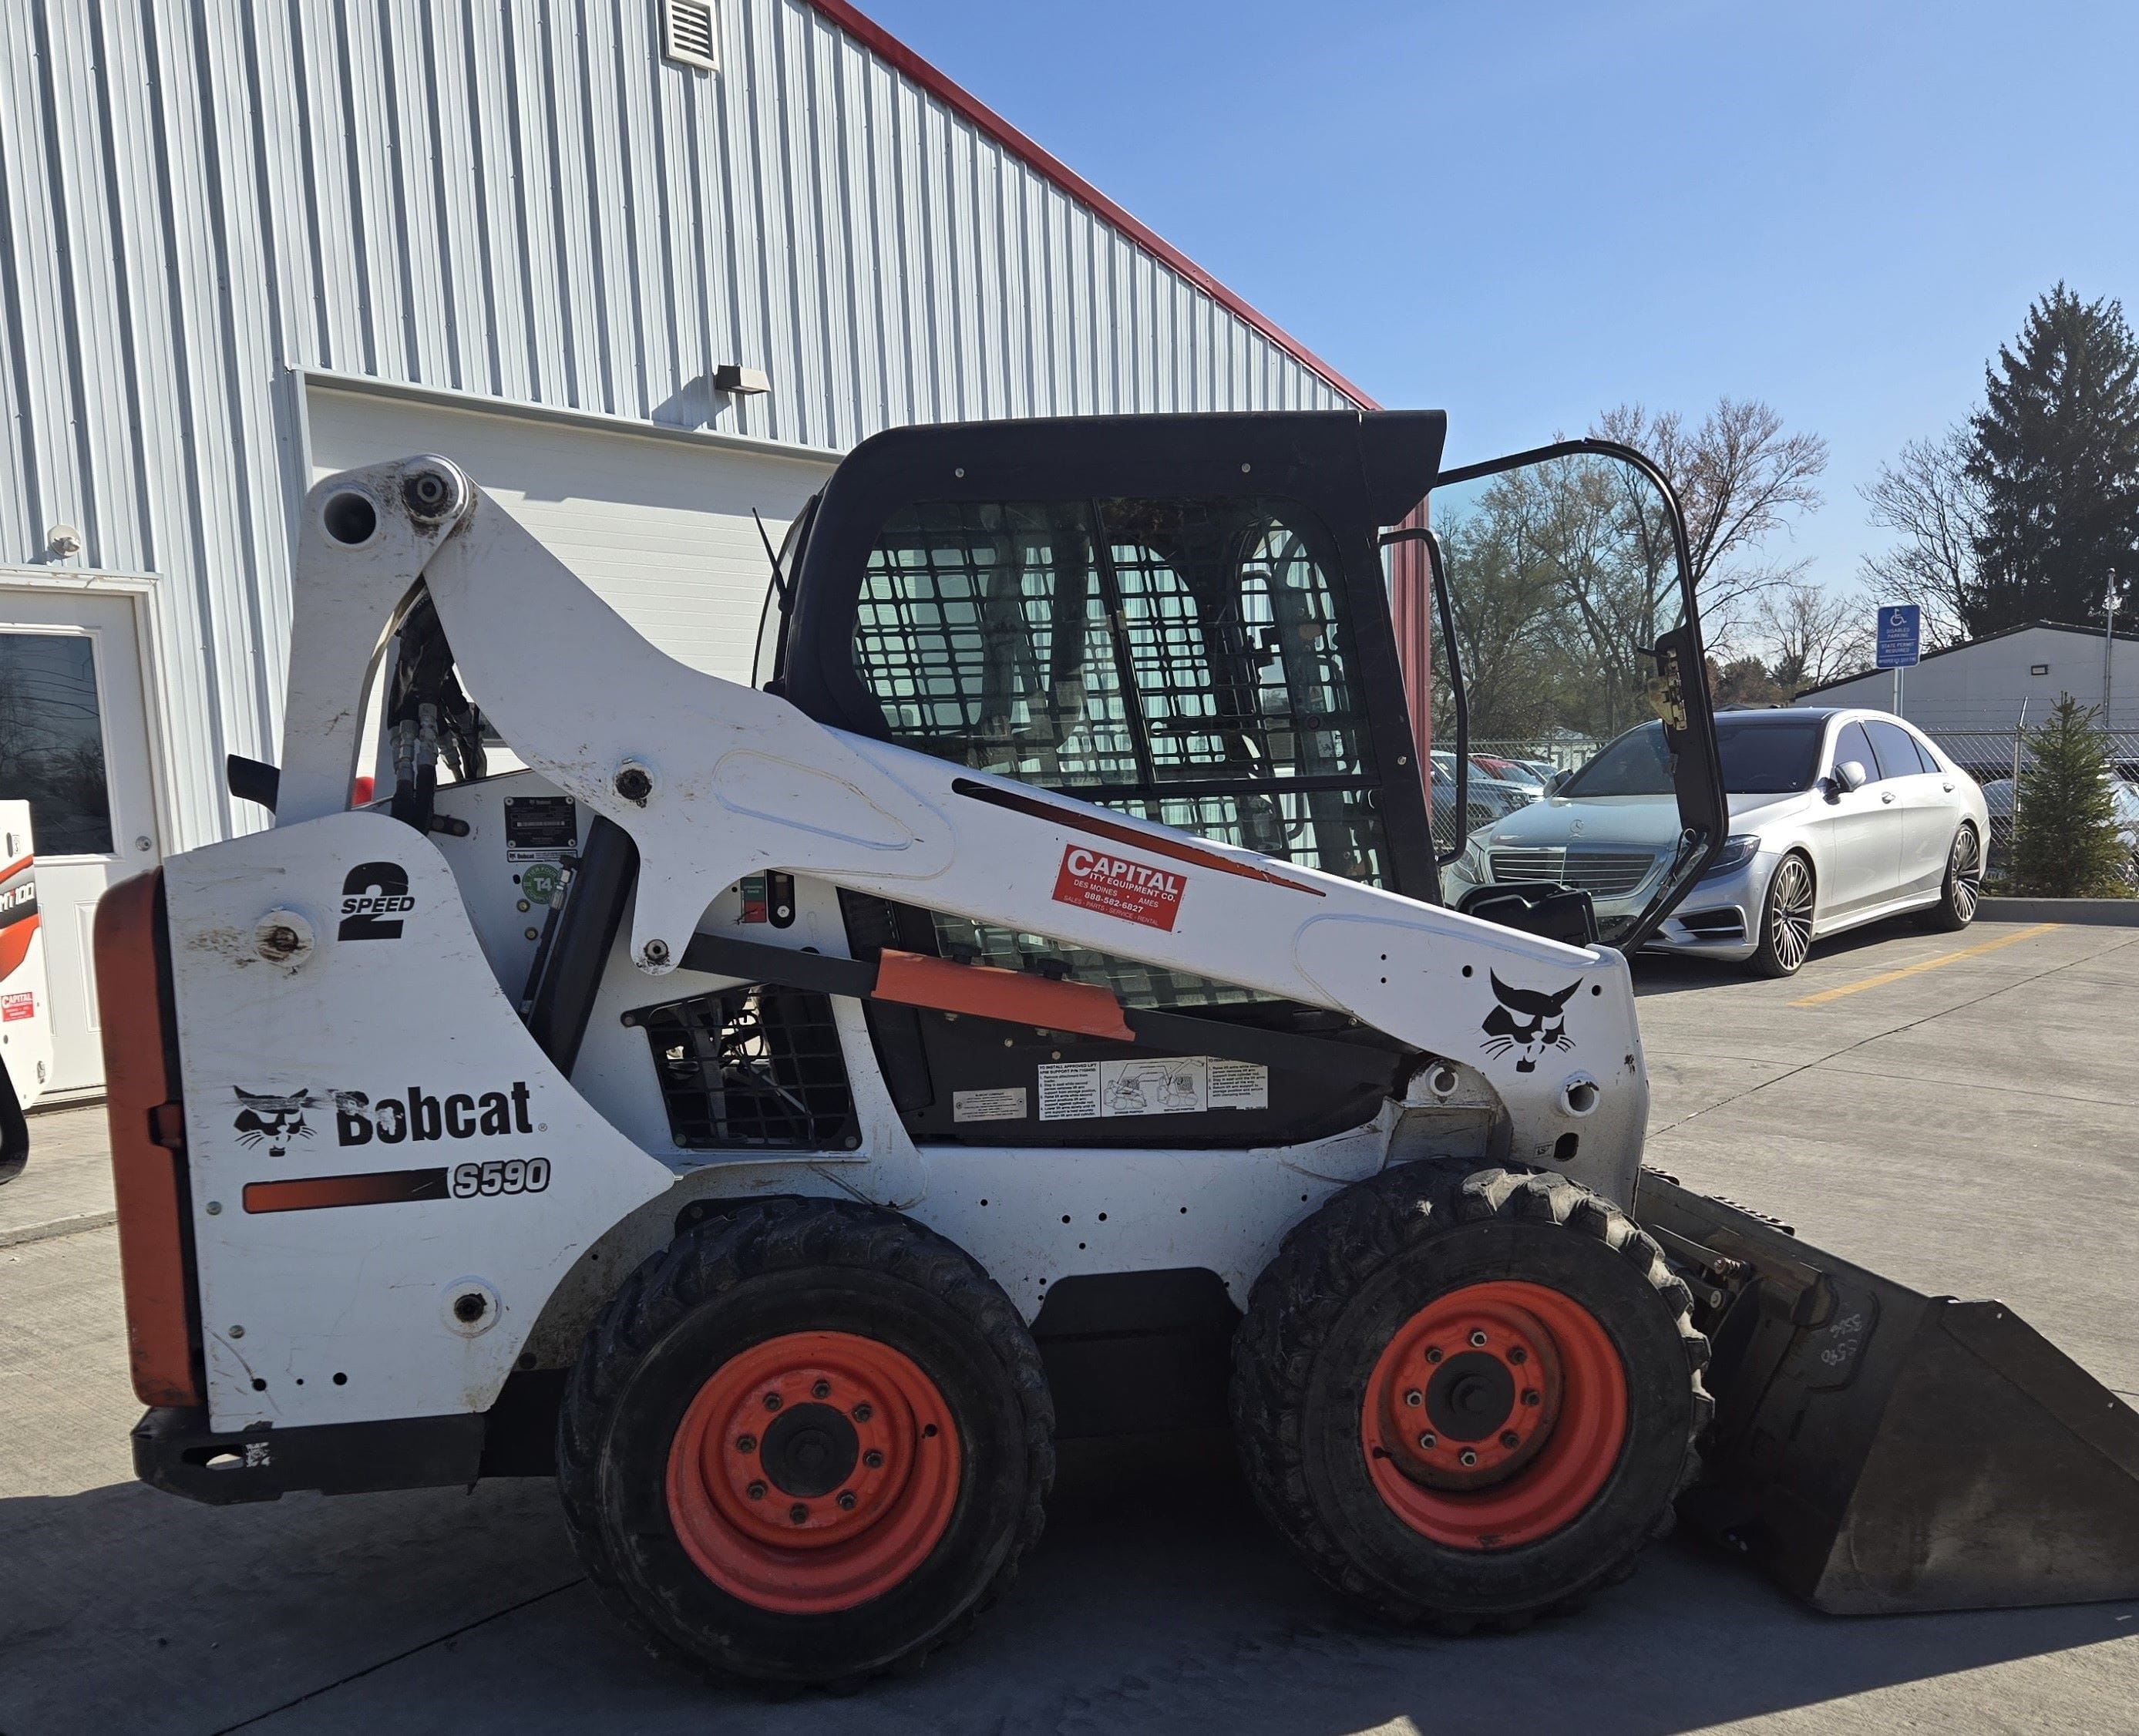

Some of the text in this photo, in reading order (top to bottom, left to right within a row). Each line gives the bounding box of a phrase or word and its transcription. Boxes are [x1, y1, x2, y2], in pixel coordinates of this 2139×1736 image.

[533, 877, 553, 891] T4
[1068, 849, 1179, 894] CAPITAL
[338, 861, 409, 941] 2
[341, 896, 415, 914] SPEED
[1074, 879, 1159, 908] DES MOINES AMES
[1085, 891, 1144, 913] 888-582-6827
[1107, 877, 1159, 899] EQUIPMENT
[1161, 893, 1175, 903] CO.
[1064, 895, 1159, 926] SALES PARTS SERVICE RENTAL
[336, 1082, 533, 1146] Bobcat
[452, 1158, 551, 1199] S590
